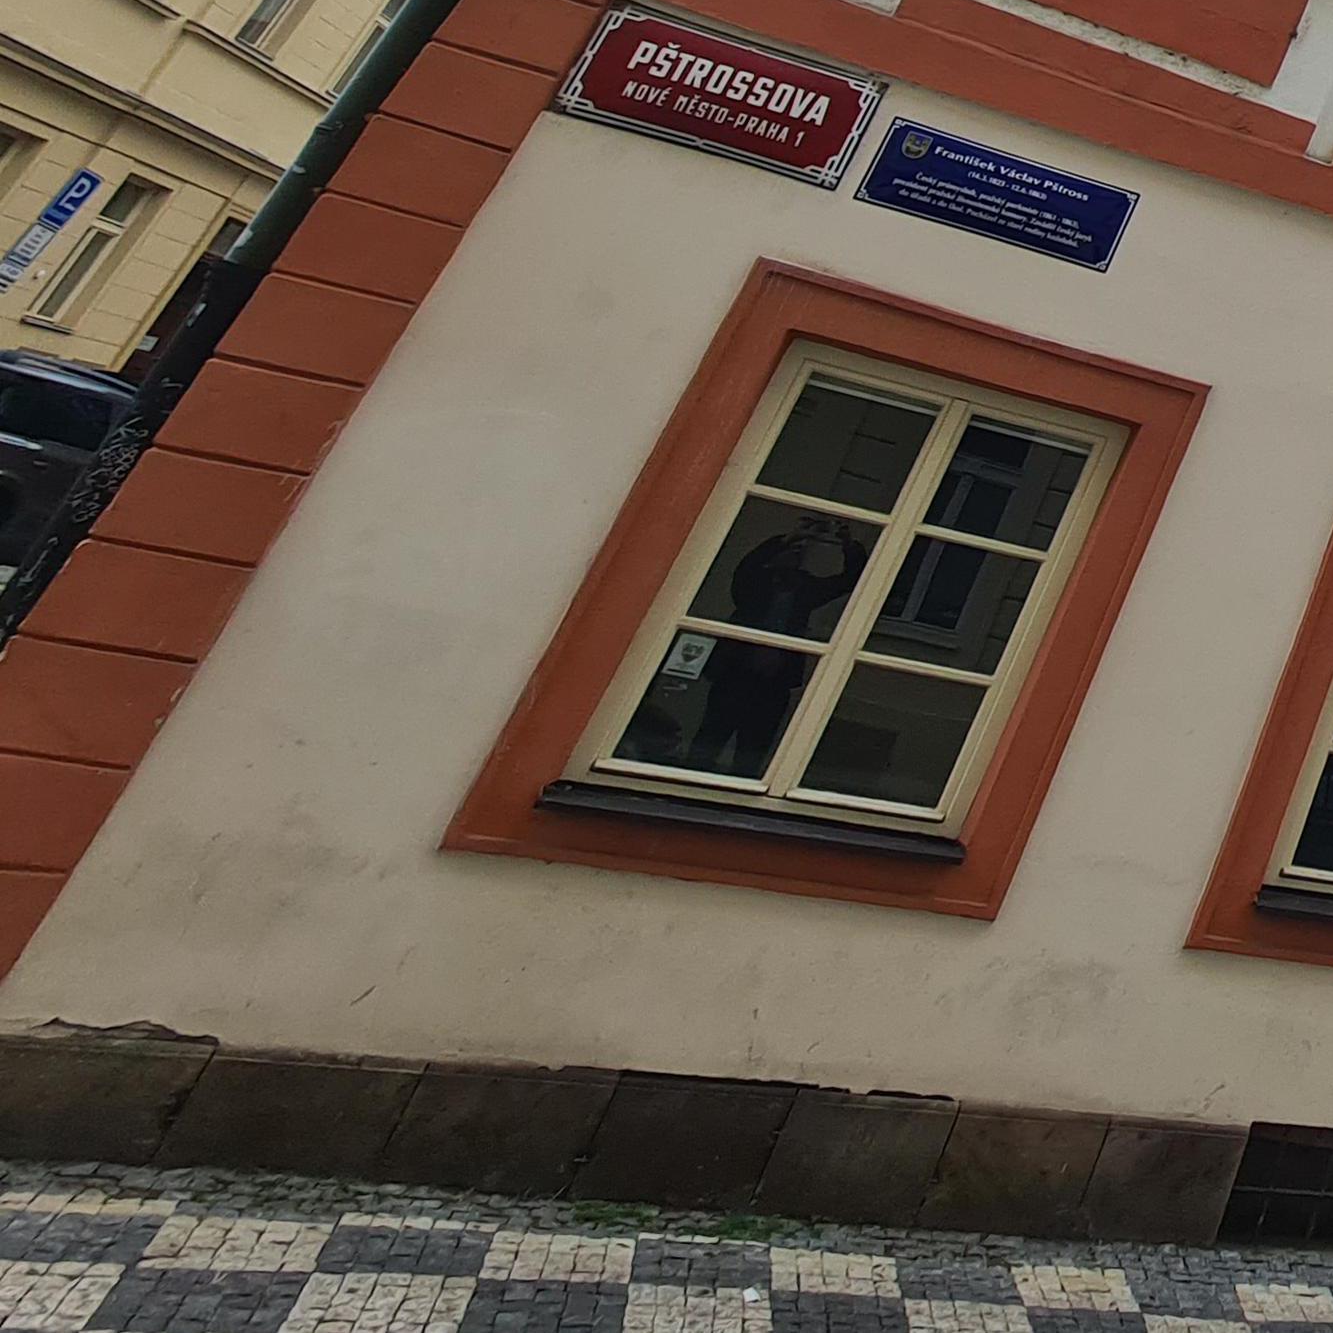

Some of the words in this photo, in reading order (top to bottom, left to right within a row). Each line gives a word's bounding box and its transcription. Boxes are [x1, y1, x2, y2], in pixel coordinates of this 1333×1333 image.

[626, 40, 831, 126] PŠTROSSOVA
[621, 80, 671, 107] NOVÉ
[673, 95, 790, 144] MĚSTO-PRAHA
[793, 131, 805, 147] 1
[58, 177, 91, 211] P
[934, 146, 996, 170] František
[998, 166, 1040, 185] Václav
[1043, 180, 1089, 200] Pštross
